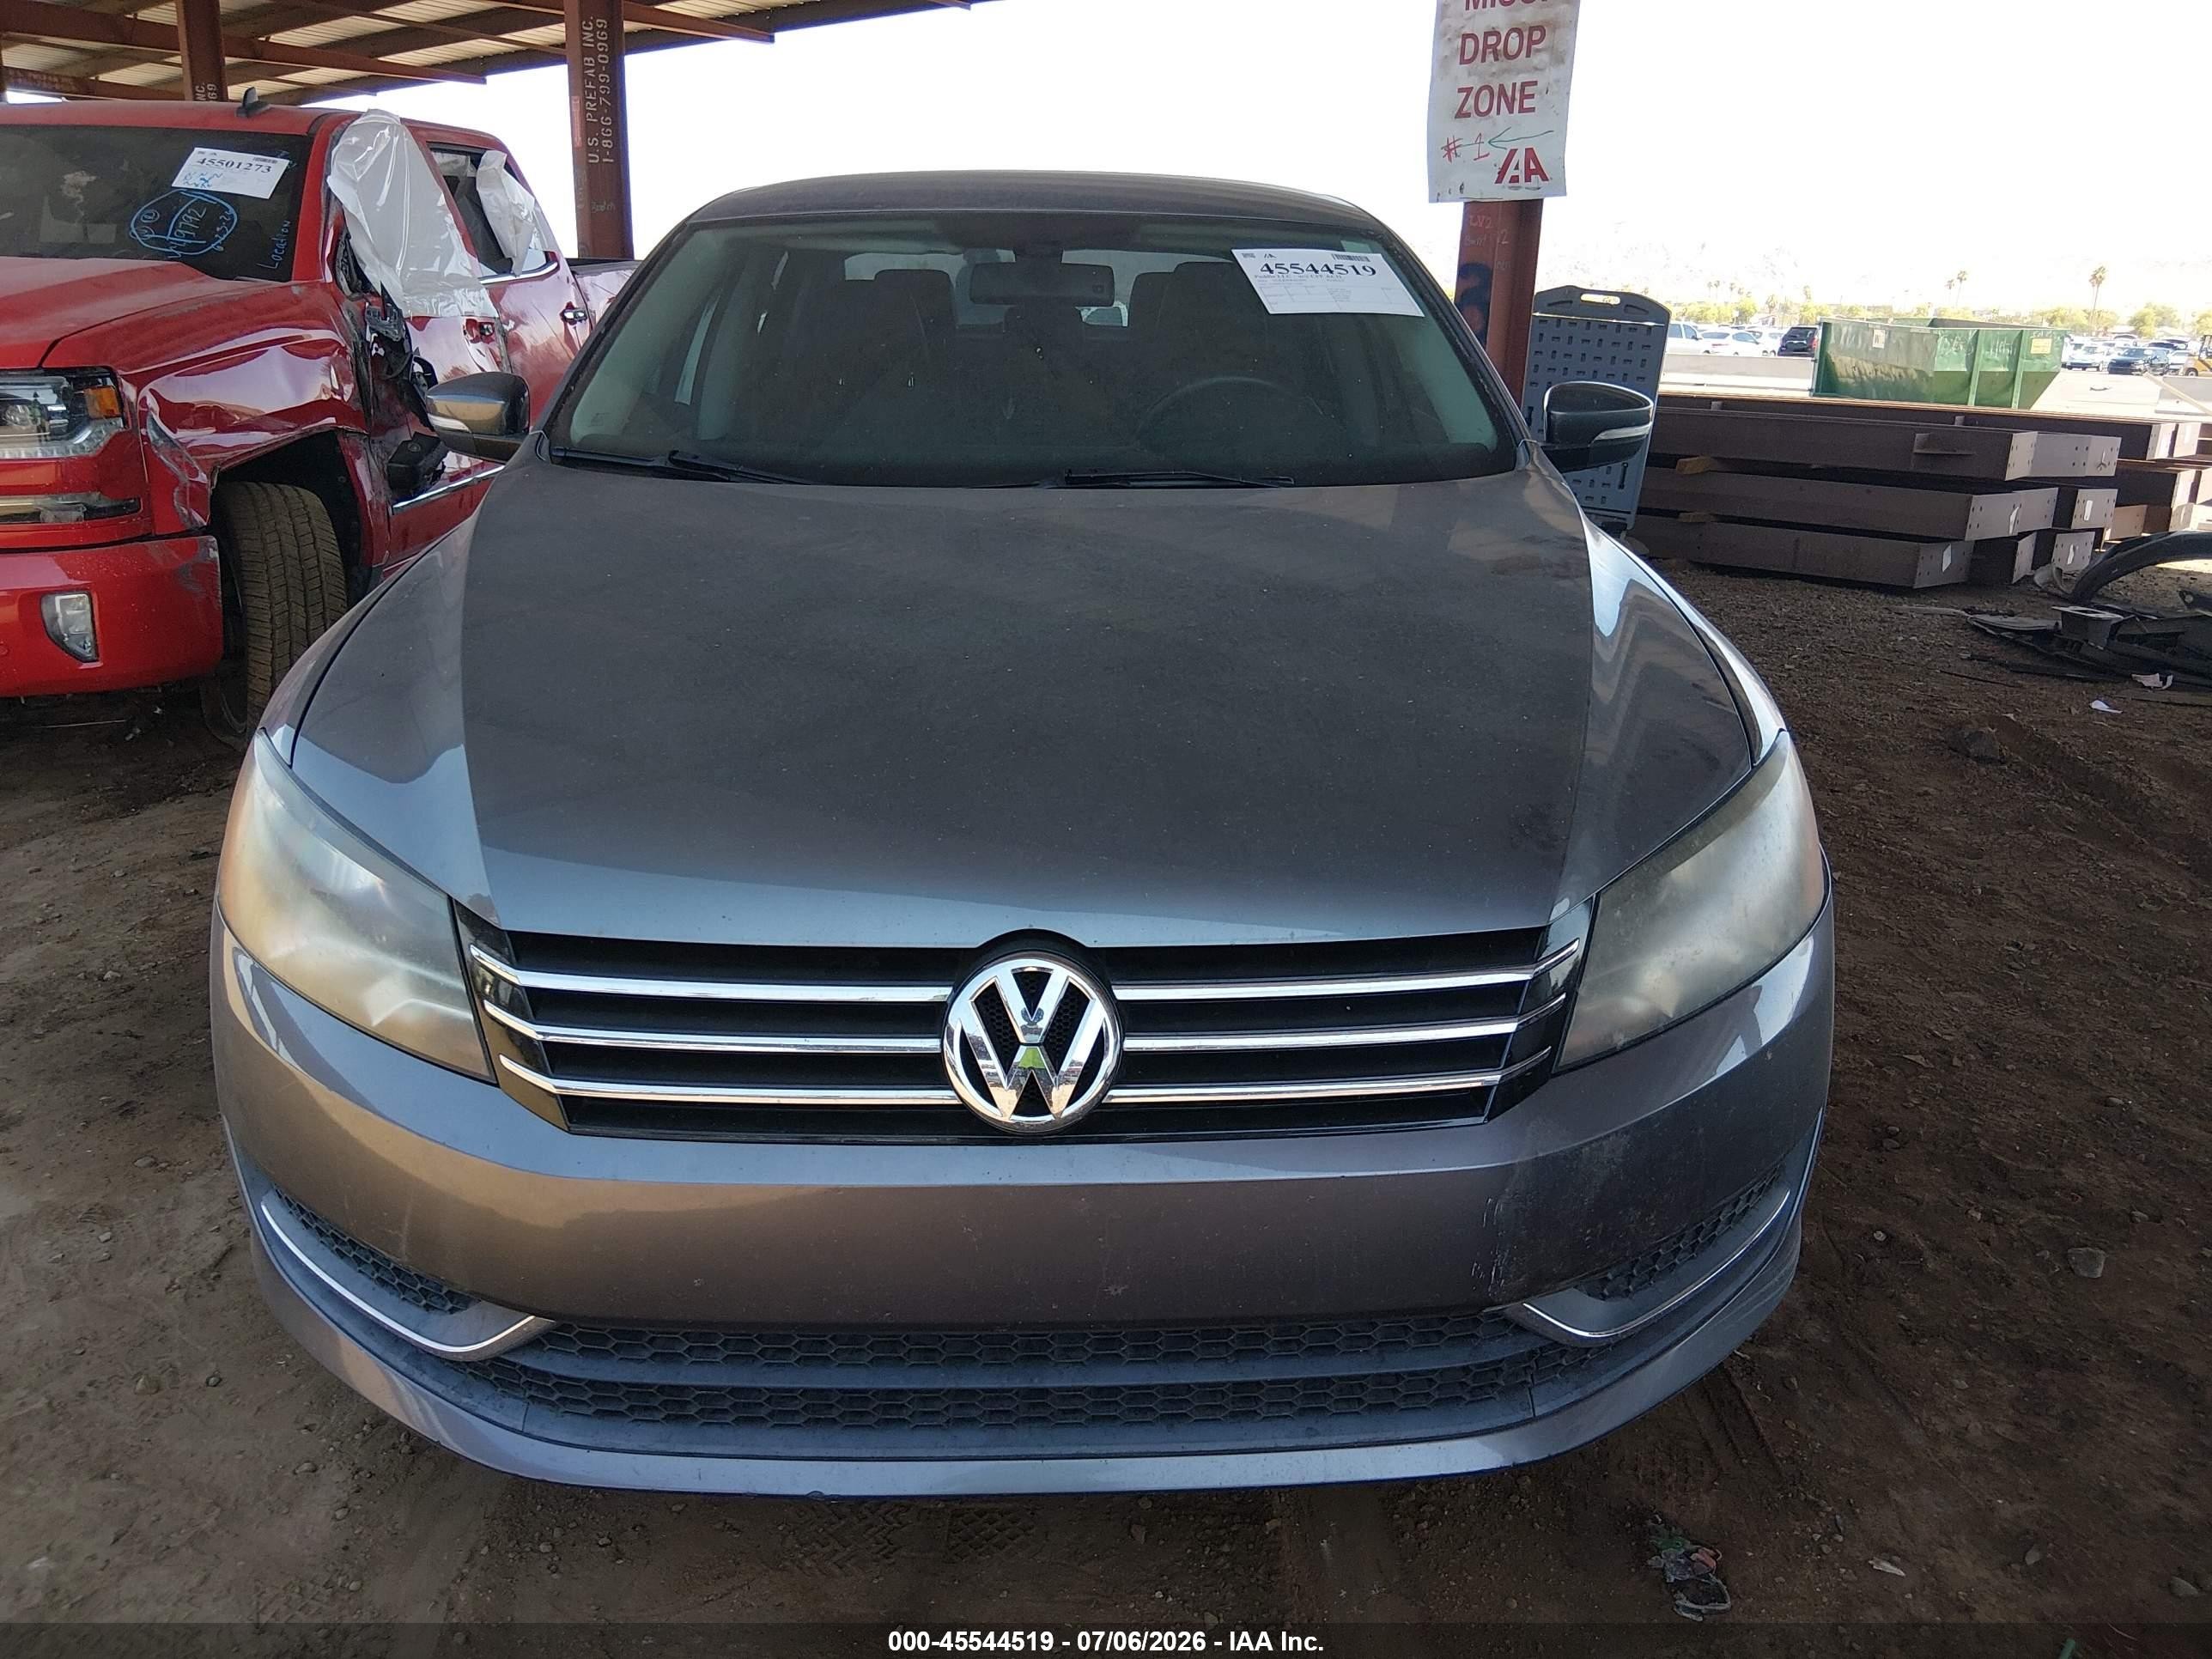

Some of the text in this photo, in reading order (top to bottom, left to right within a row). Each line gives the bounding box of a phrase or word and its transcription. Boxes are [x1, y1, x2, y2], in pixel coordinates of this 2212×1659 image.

[1459, 25, 1547, 65] DROP
[581, 16, 599, 164] U.S. PREFAB INC.
[596, 18, 615, 163] 1-866-799-0969
[1454, 81, 1539, 119] ZONE
[197, 157, 272, 173] 45501273
[1260, 263, 1376, 276] 45544519
